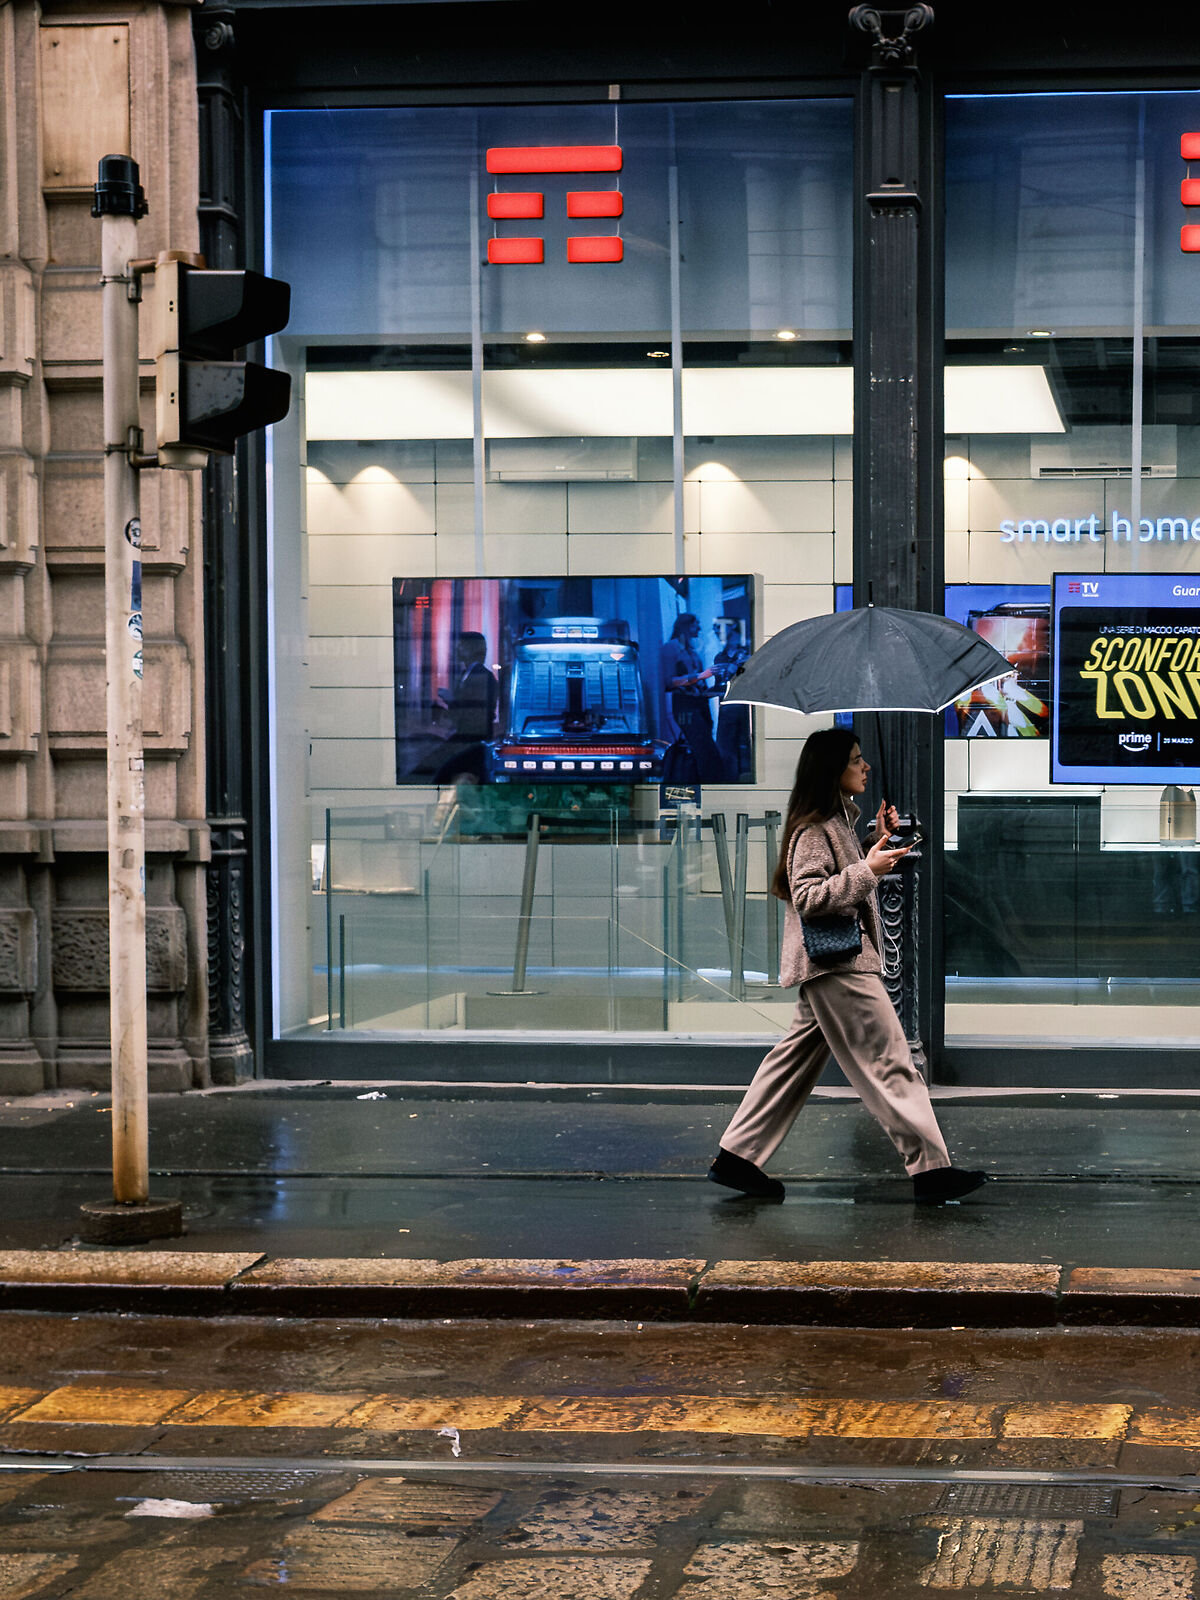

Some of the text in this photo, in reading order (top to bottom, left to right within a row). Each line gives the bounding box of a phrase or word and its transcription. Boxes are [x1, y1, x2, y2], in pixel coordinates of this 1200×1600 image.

[999, 513, 1101, 543] smart
[1081, 582, 1099, 593] TV
[1118, 731, 1152, 745] prime
